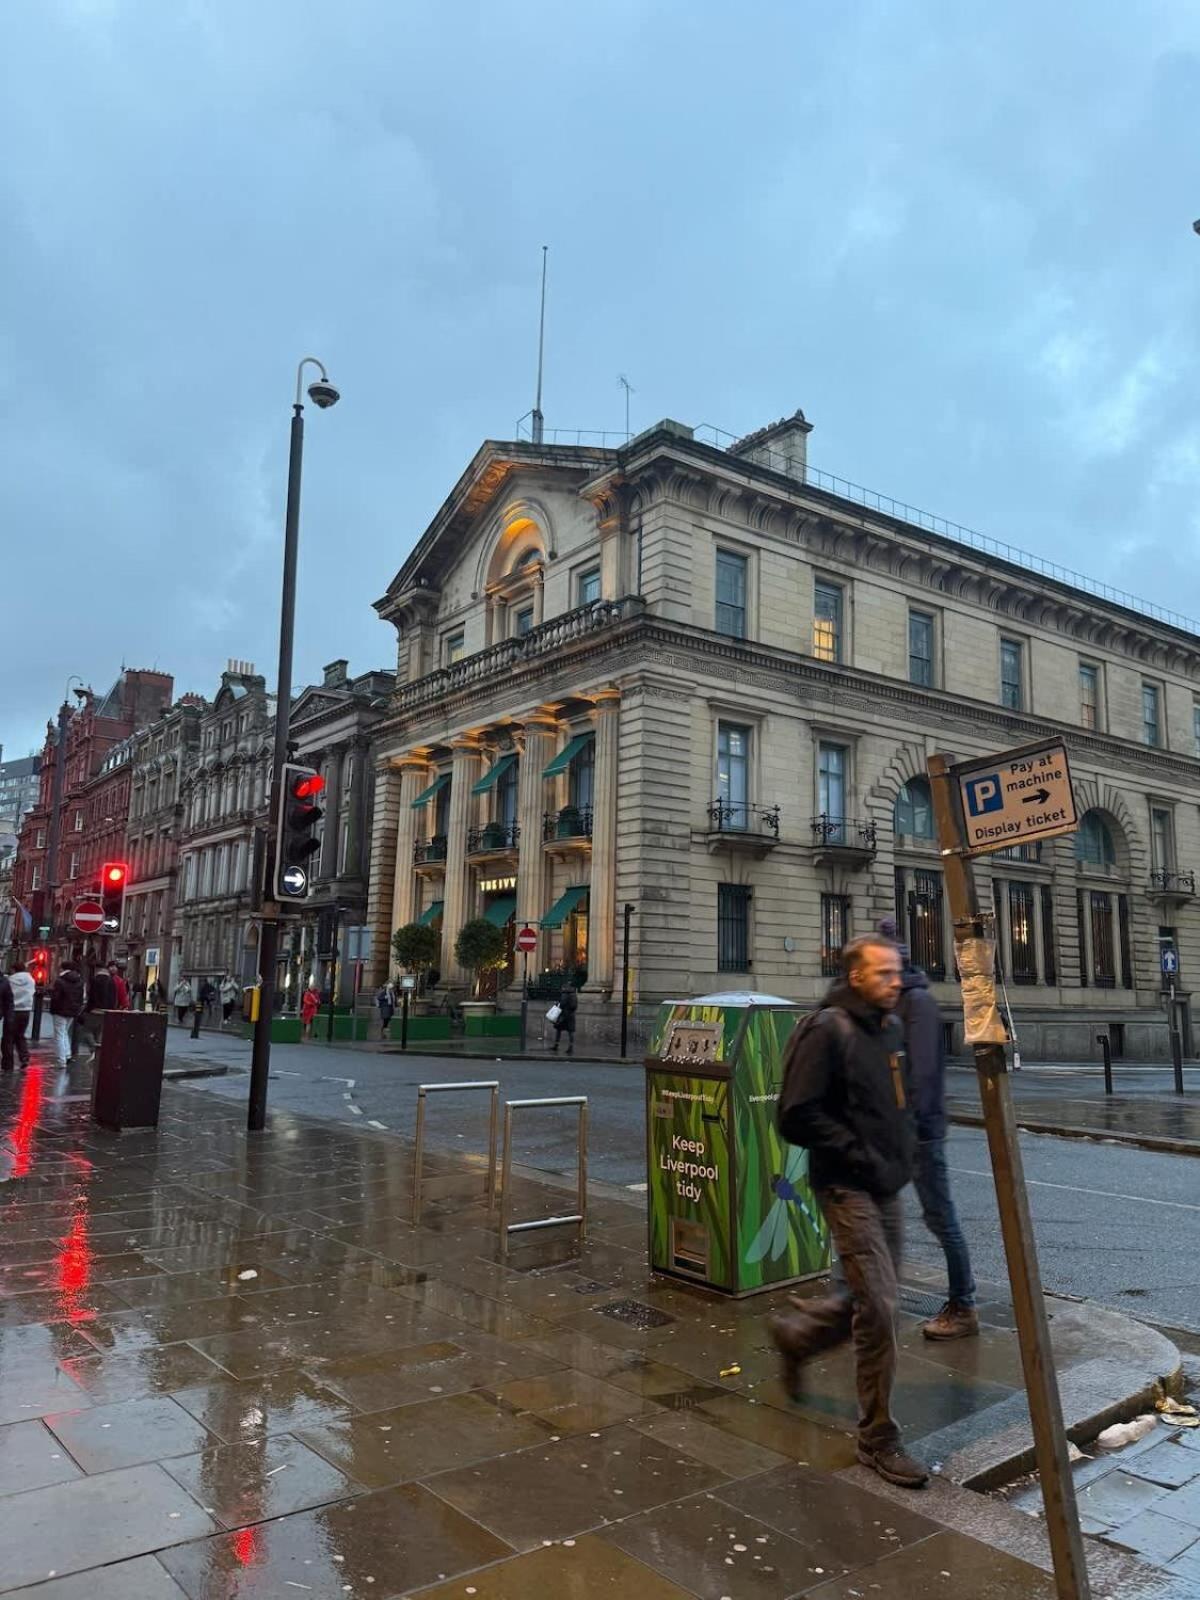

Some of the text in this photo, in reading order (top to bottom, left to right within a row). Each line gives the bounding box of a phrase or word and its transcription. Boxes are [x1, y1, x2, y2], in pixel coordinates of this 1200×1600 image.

[1010, 754, 1053, 775] Pay at
[1006, 770, 1062, 792] machine
[974, 780, 997, 812] P
[975, 808, 1066, 839] Display ticket
[499, 877, 516, 889] IVY
[672, 1134, 705, 1157] Keep
[660, 1154, 719, 1181] Liverpool
[676, 1180, 702, 1203] tidy
